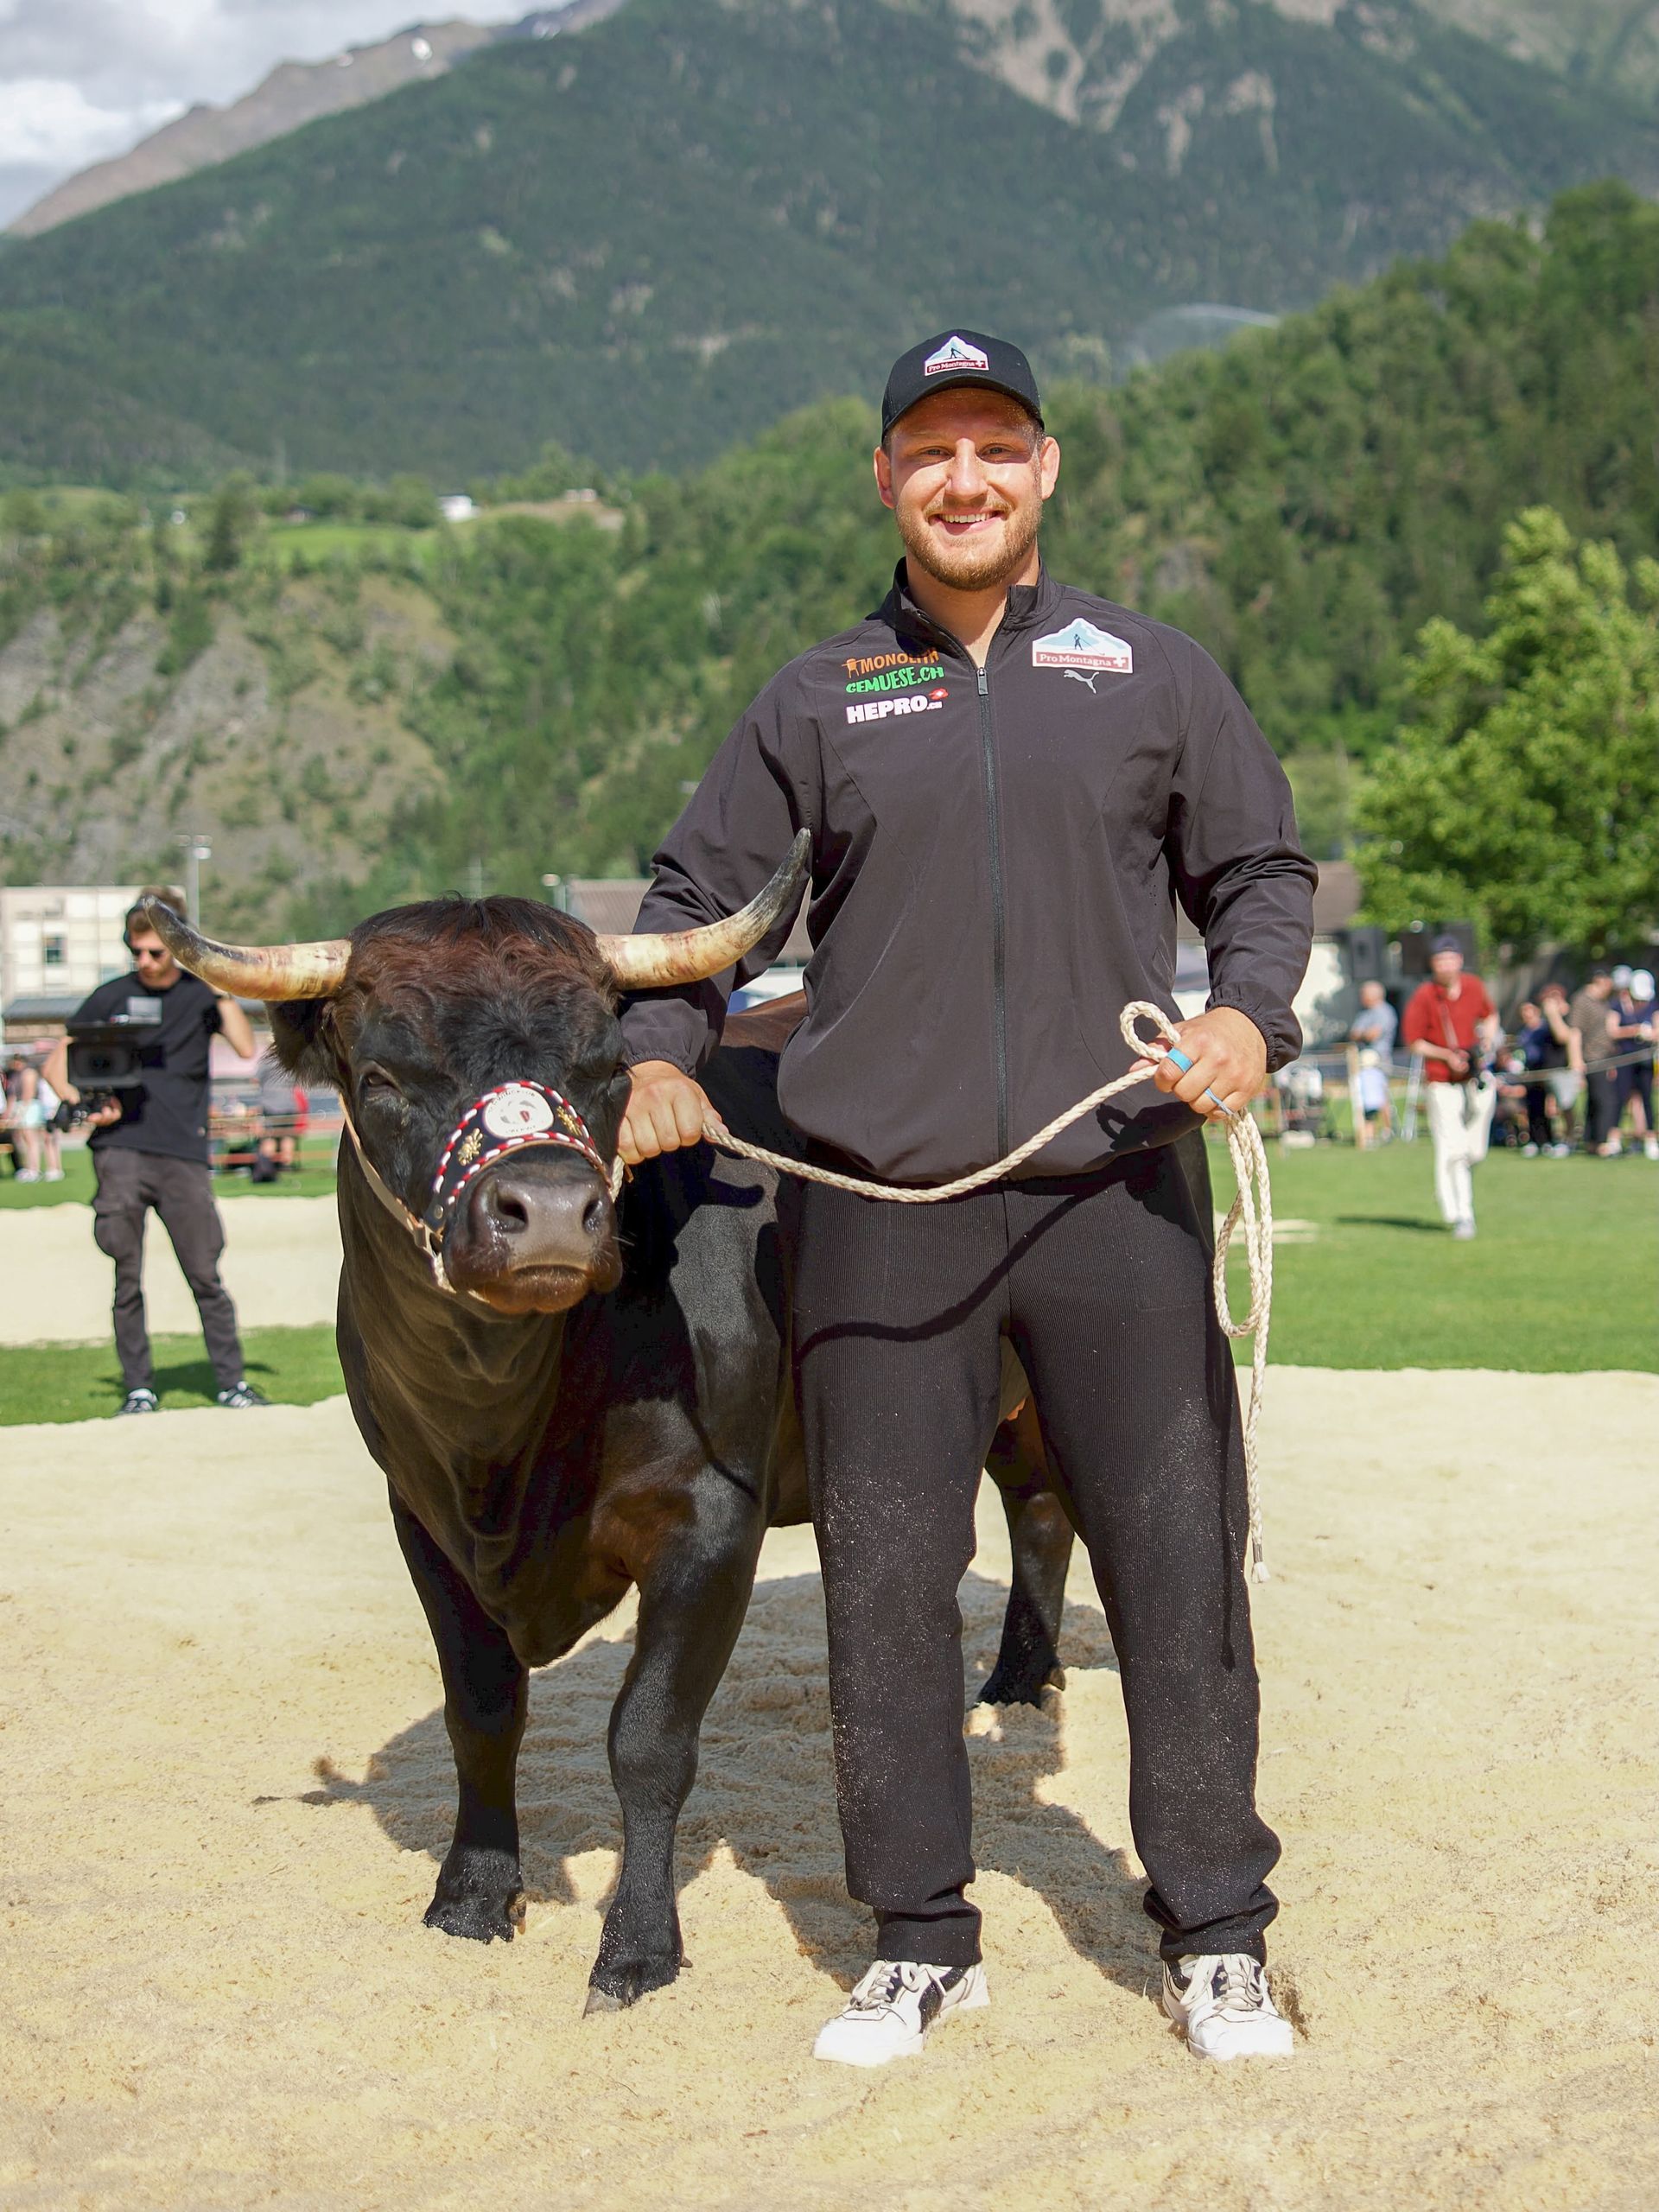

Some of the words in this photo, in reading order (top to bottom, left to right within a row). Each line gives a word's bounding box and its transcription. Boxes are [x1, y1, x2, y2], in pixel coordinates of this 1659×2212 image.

[928, 364, 941, 372] Pro
[941, 361, 976, 370] Montagna
[1039, 653, 1058, 663] Pro
[1058, 654, 1112, 667] Montagna
[845, 666, 945, 694] GEMUESE.CH
